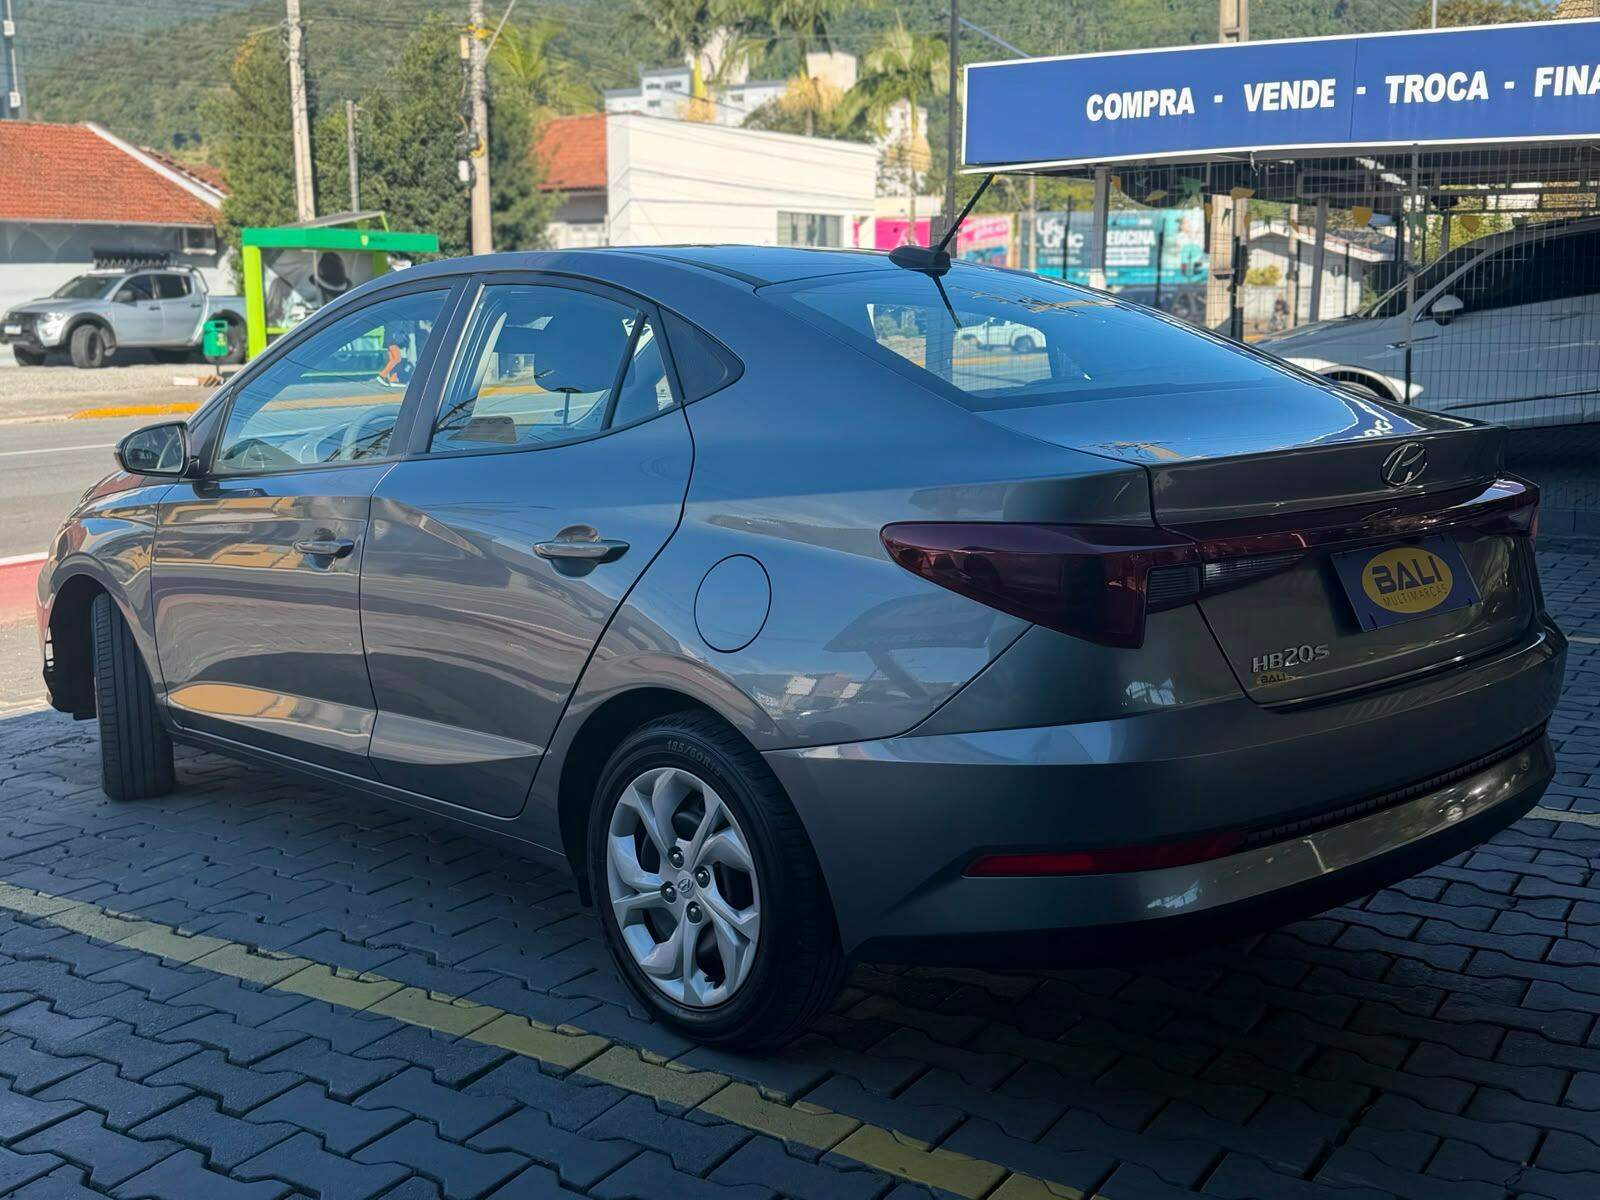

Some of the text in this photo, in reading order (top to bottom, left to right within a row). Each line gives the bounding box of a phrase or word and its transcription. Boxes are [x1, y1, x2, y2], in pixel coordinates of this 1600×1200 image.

[1086, 87, 1195, 121] COMPRA
[1243, 78, 1337, 112] VENDE
[1384, 71, 1489, 104] TROCA
[1372, 555, 1443, 594] BALI
[1382, 583, 1449, 607] MULTIMARCAS
